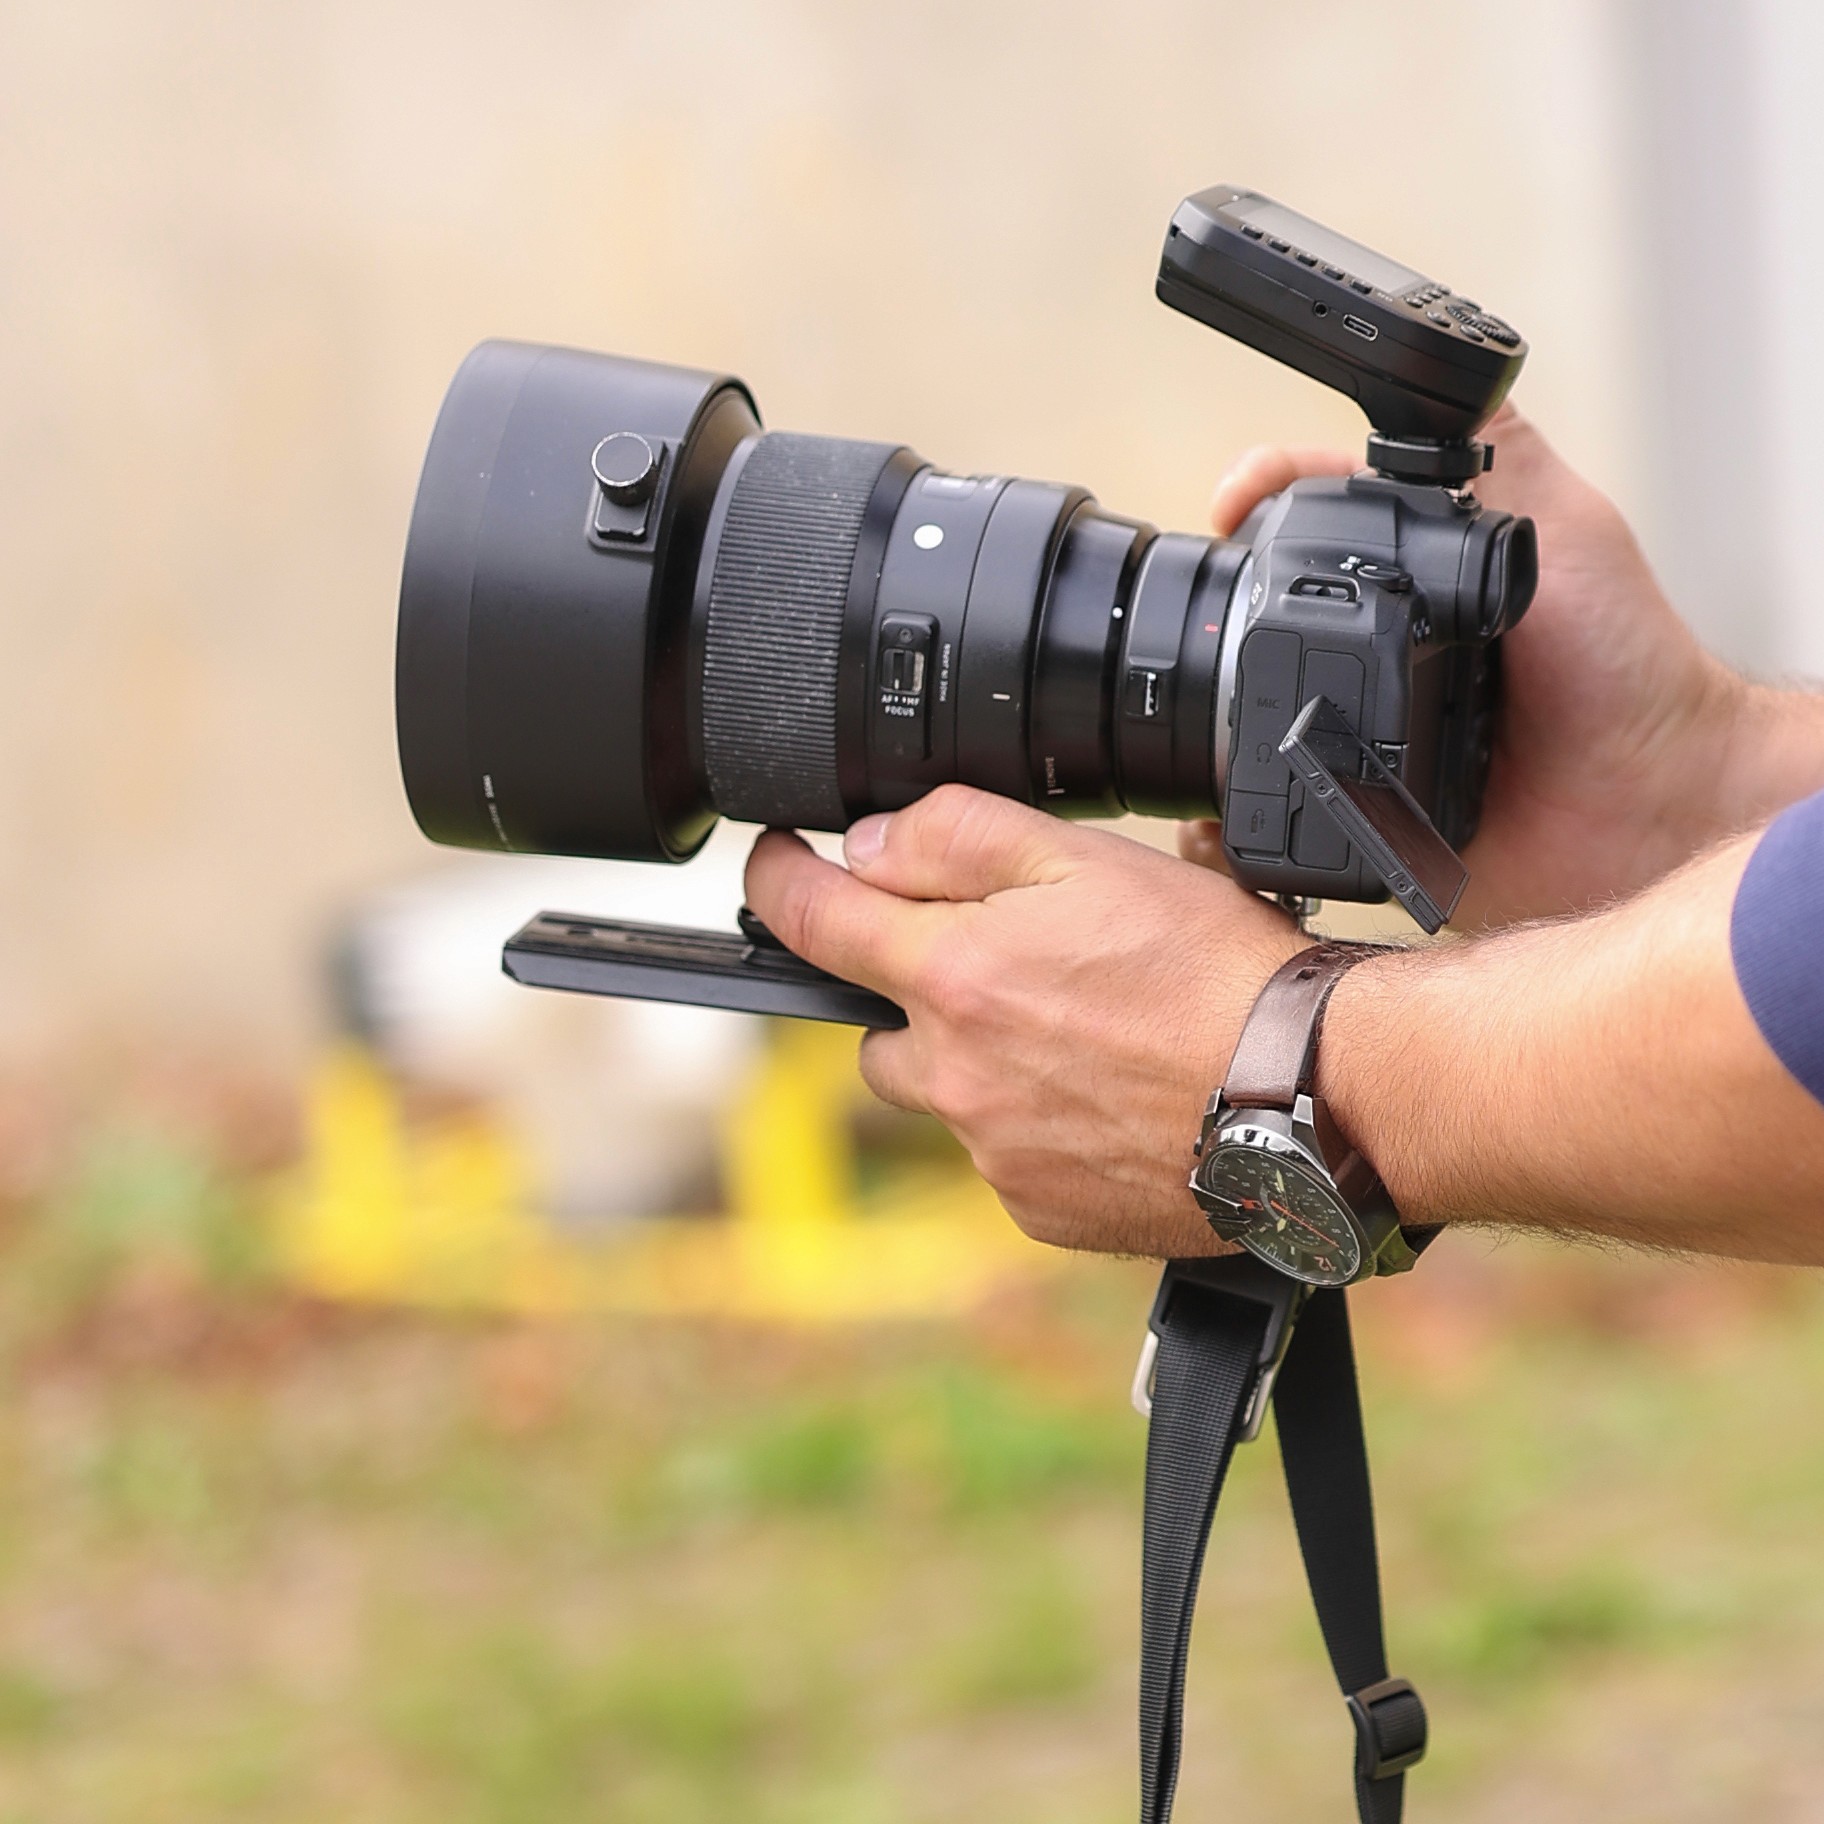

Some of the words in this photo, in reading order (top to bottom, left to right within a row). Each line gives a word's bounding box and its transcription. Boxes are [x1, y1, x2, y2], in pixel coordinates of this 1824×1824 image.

[1257, 697, 1281, 709] MIC
[885, 705, 915, 717] FOCUS
[1313, 1256, 1337, 1272] 12
